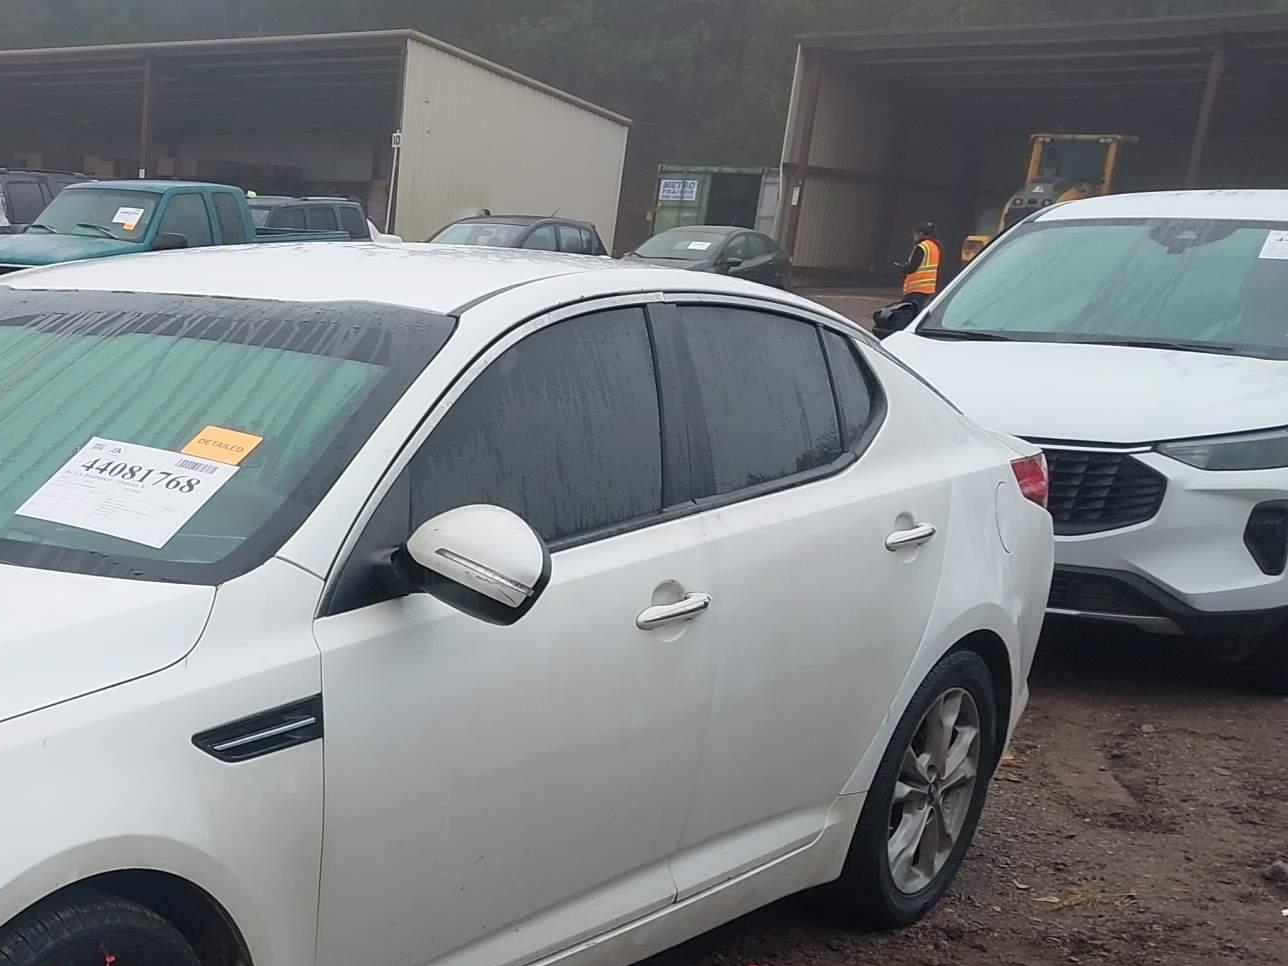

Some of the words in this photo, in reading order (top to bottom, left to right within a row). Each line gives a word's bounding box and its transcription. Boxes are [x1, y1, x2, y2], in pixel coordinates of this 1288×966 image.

[393, 135, 401, 146] 10
[197, 438, 245, 453] DETAILED
[81, 457, 201, 494] 44081768
